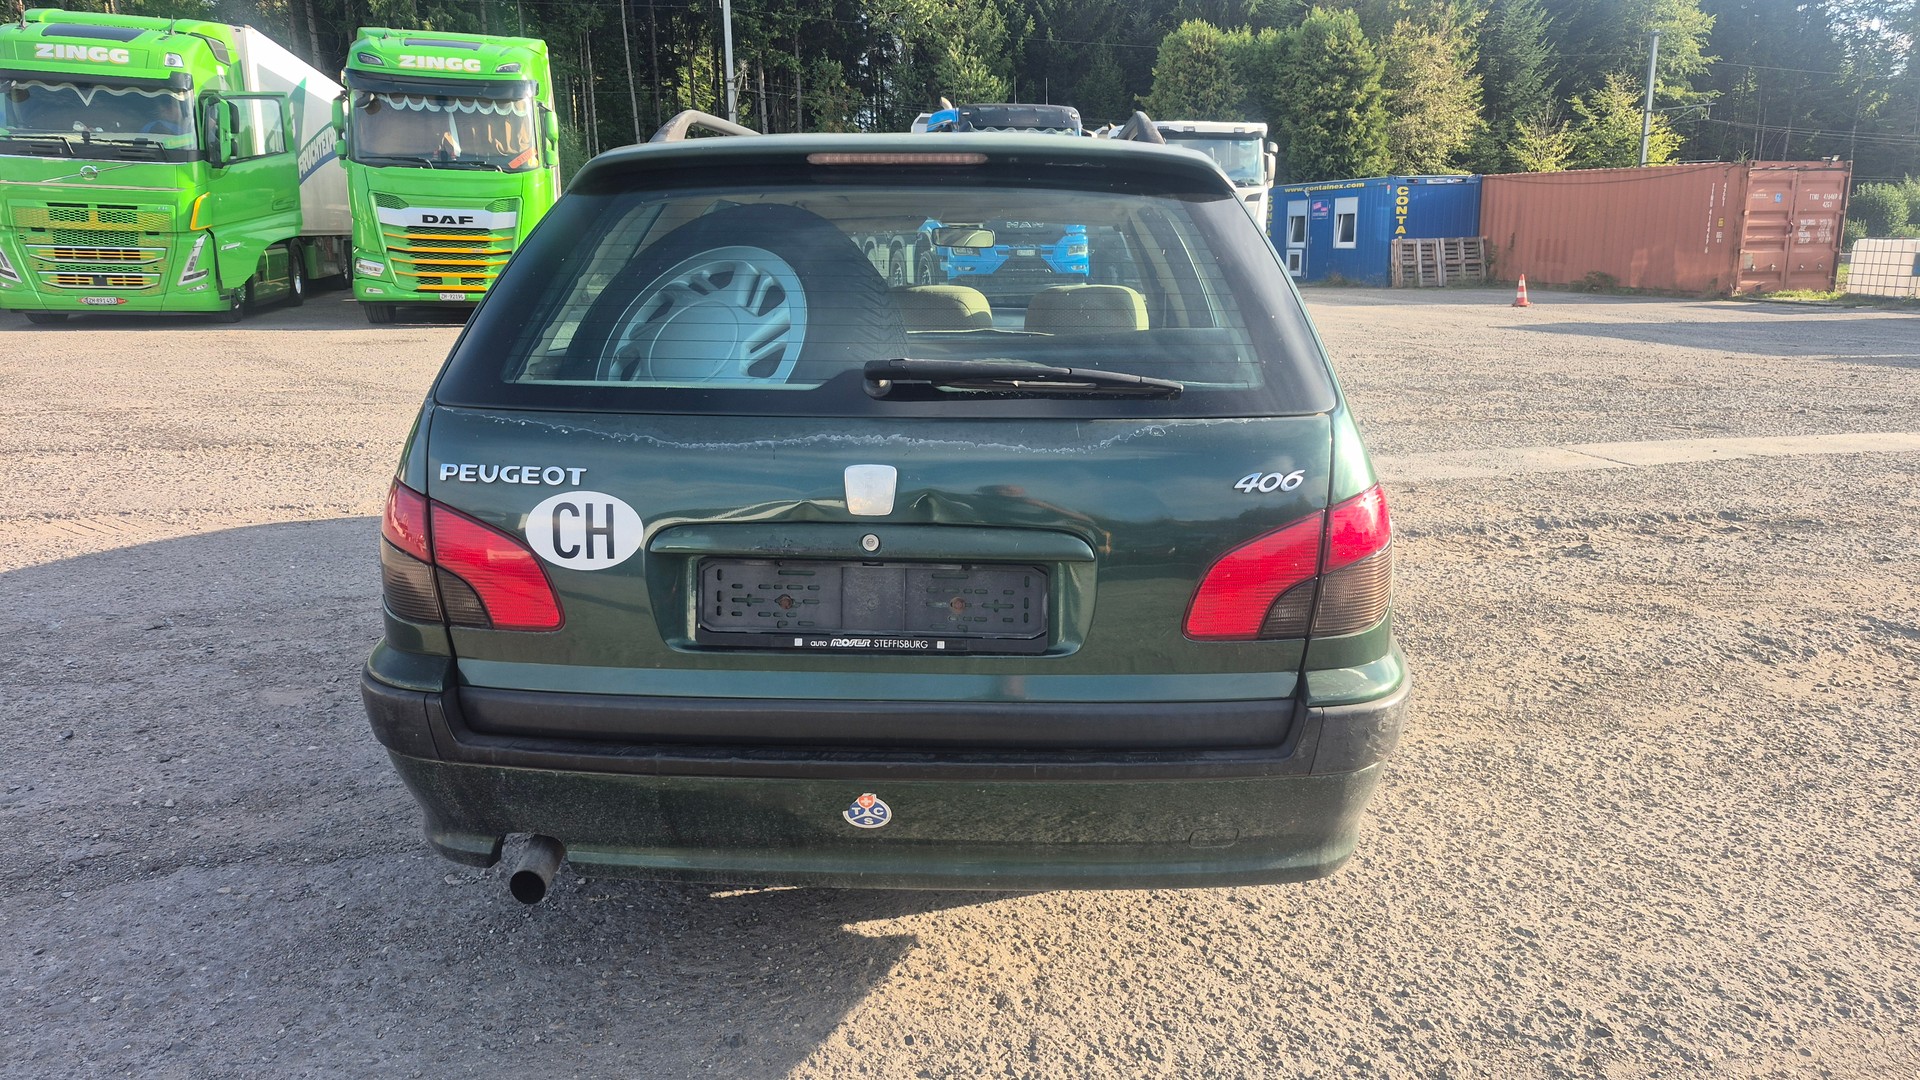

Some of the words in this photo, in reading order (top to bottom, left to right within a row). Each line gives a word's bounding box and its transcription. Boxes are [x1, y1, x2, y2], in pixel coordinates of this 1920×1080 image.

[35, 43, 129, 64] ZINGG
[398, 54, 481, 72] ZINGG
[1285, 182, 1365, 193] www.containex.com
[422, 214, 474, 224] DAF
[1395, 186, 1409, 240] CONTA
[1006, 221, 1044, 229] MAN
[440, 463, 587, 486] PEUGEOT
[1234, 469, 1306, 493] 406
[552, 502, 615, 560] CH
[873, 639, 929, 649] STEFFISBURG
